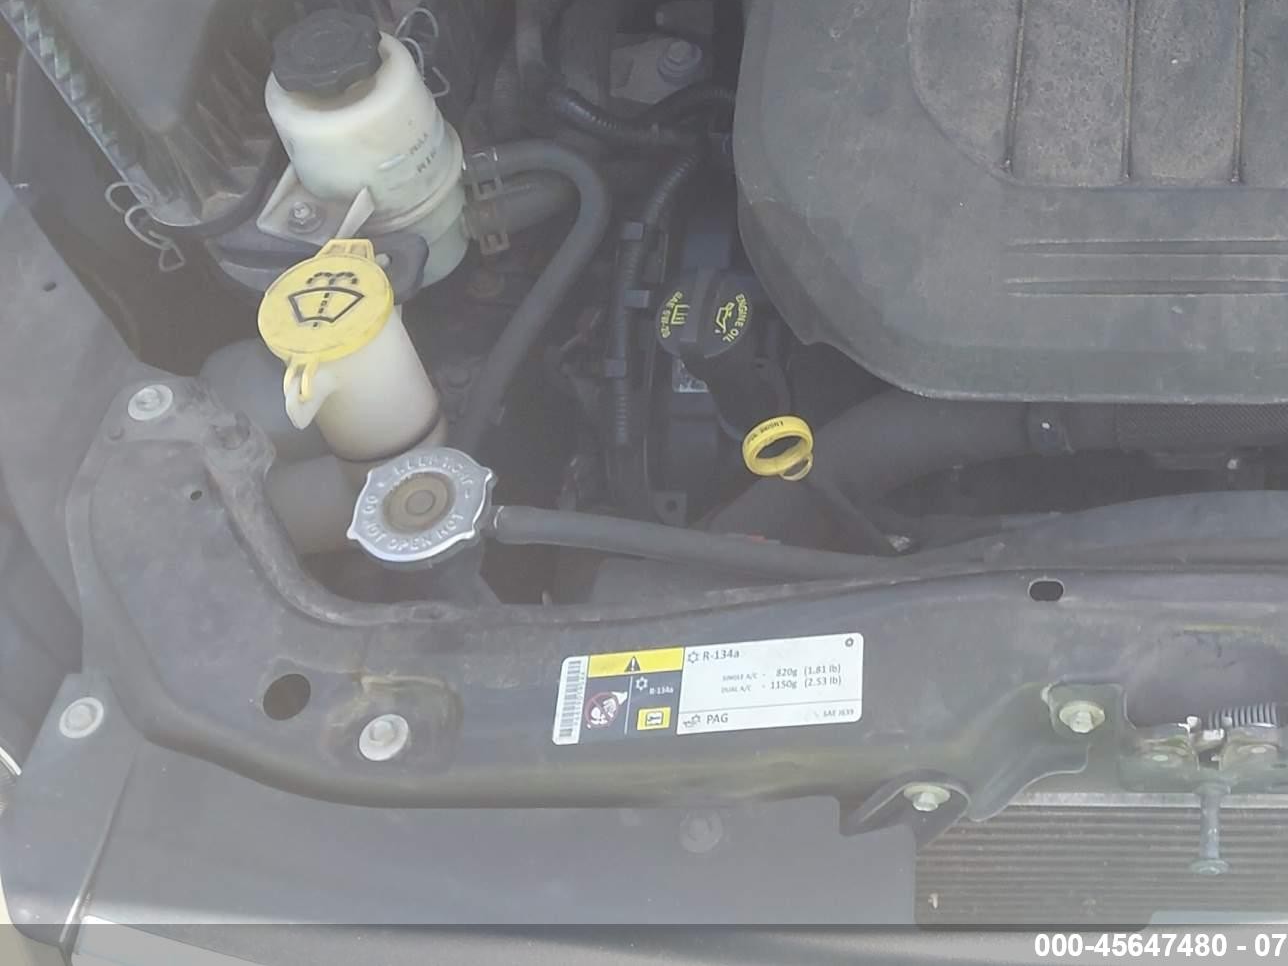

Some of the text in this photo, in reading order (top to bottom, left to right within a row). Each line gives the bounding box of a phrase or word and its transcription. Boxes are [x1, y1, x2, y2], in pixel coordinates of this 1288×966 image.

[722, 293, 748, 342] ENGINE OIL
[386, 537, 433, 552] OPEN
[702, 649, 740, 661] R-134a
[775, 666, 798, 678] 820g
[828, 663, 841, 674] lb)
[770, 680, 798, 691] 1150g
[804, 676, 827, 689] (2.53
[829, 675, 842, 686] lb)
[706, 713, 729, 725] PAG
